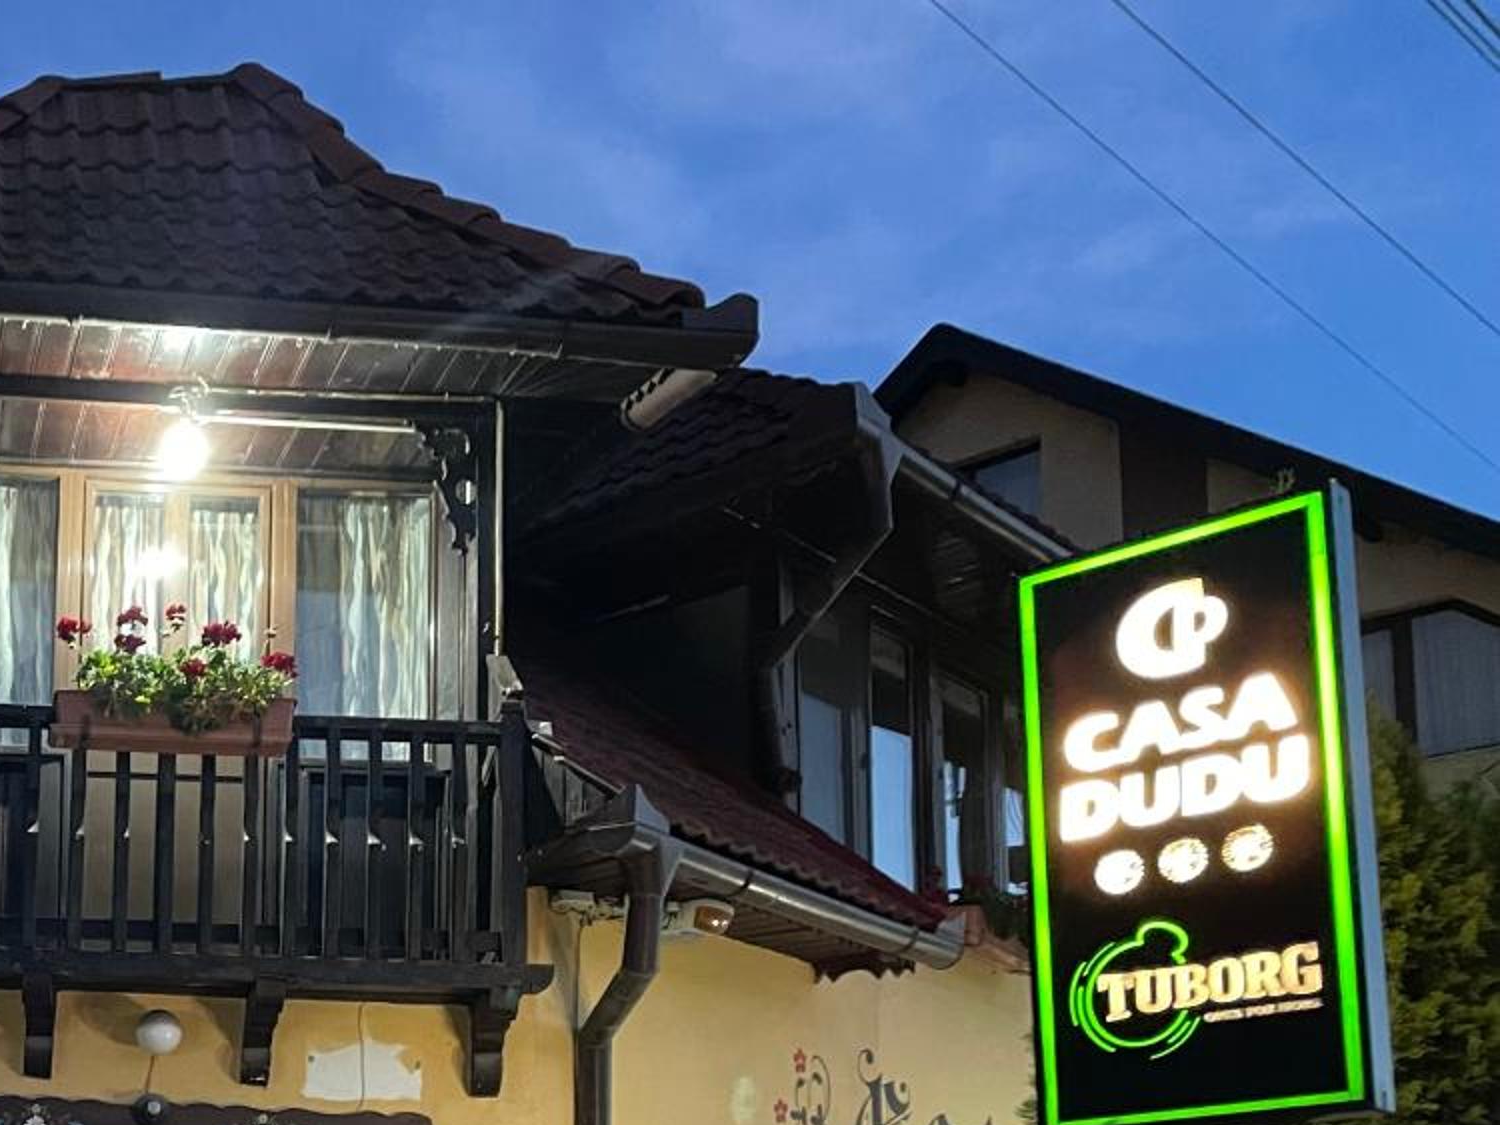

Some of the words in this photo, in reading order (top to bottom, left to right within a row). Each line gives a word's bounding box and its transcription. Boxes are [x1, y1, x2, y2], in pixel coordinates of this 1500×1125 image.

[1063, 671, 1298, 773] CASA
[1059, 734, 1311, 844] DUDU
[1097, 941, 1323, 1023] TUBORG
